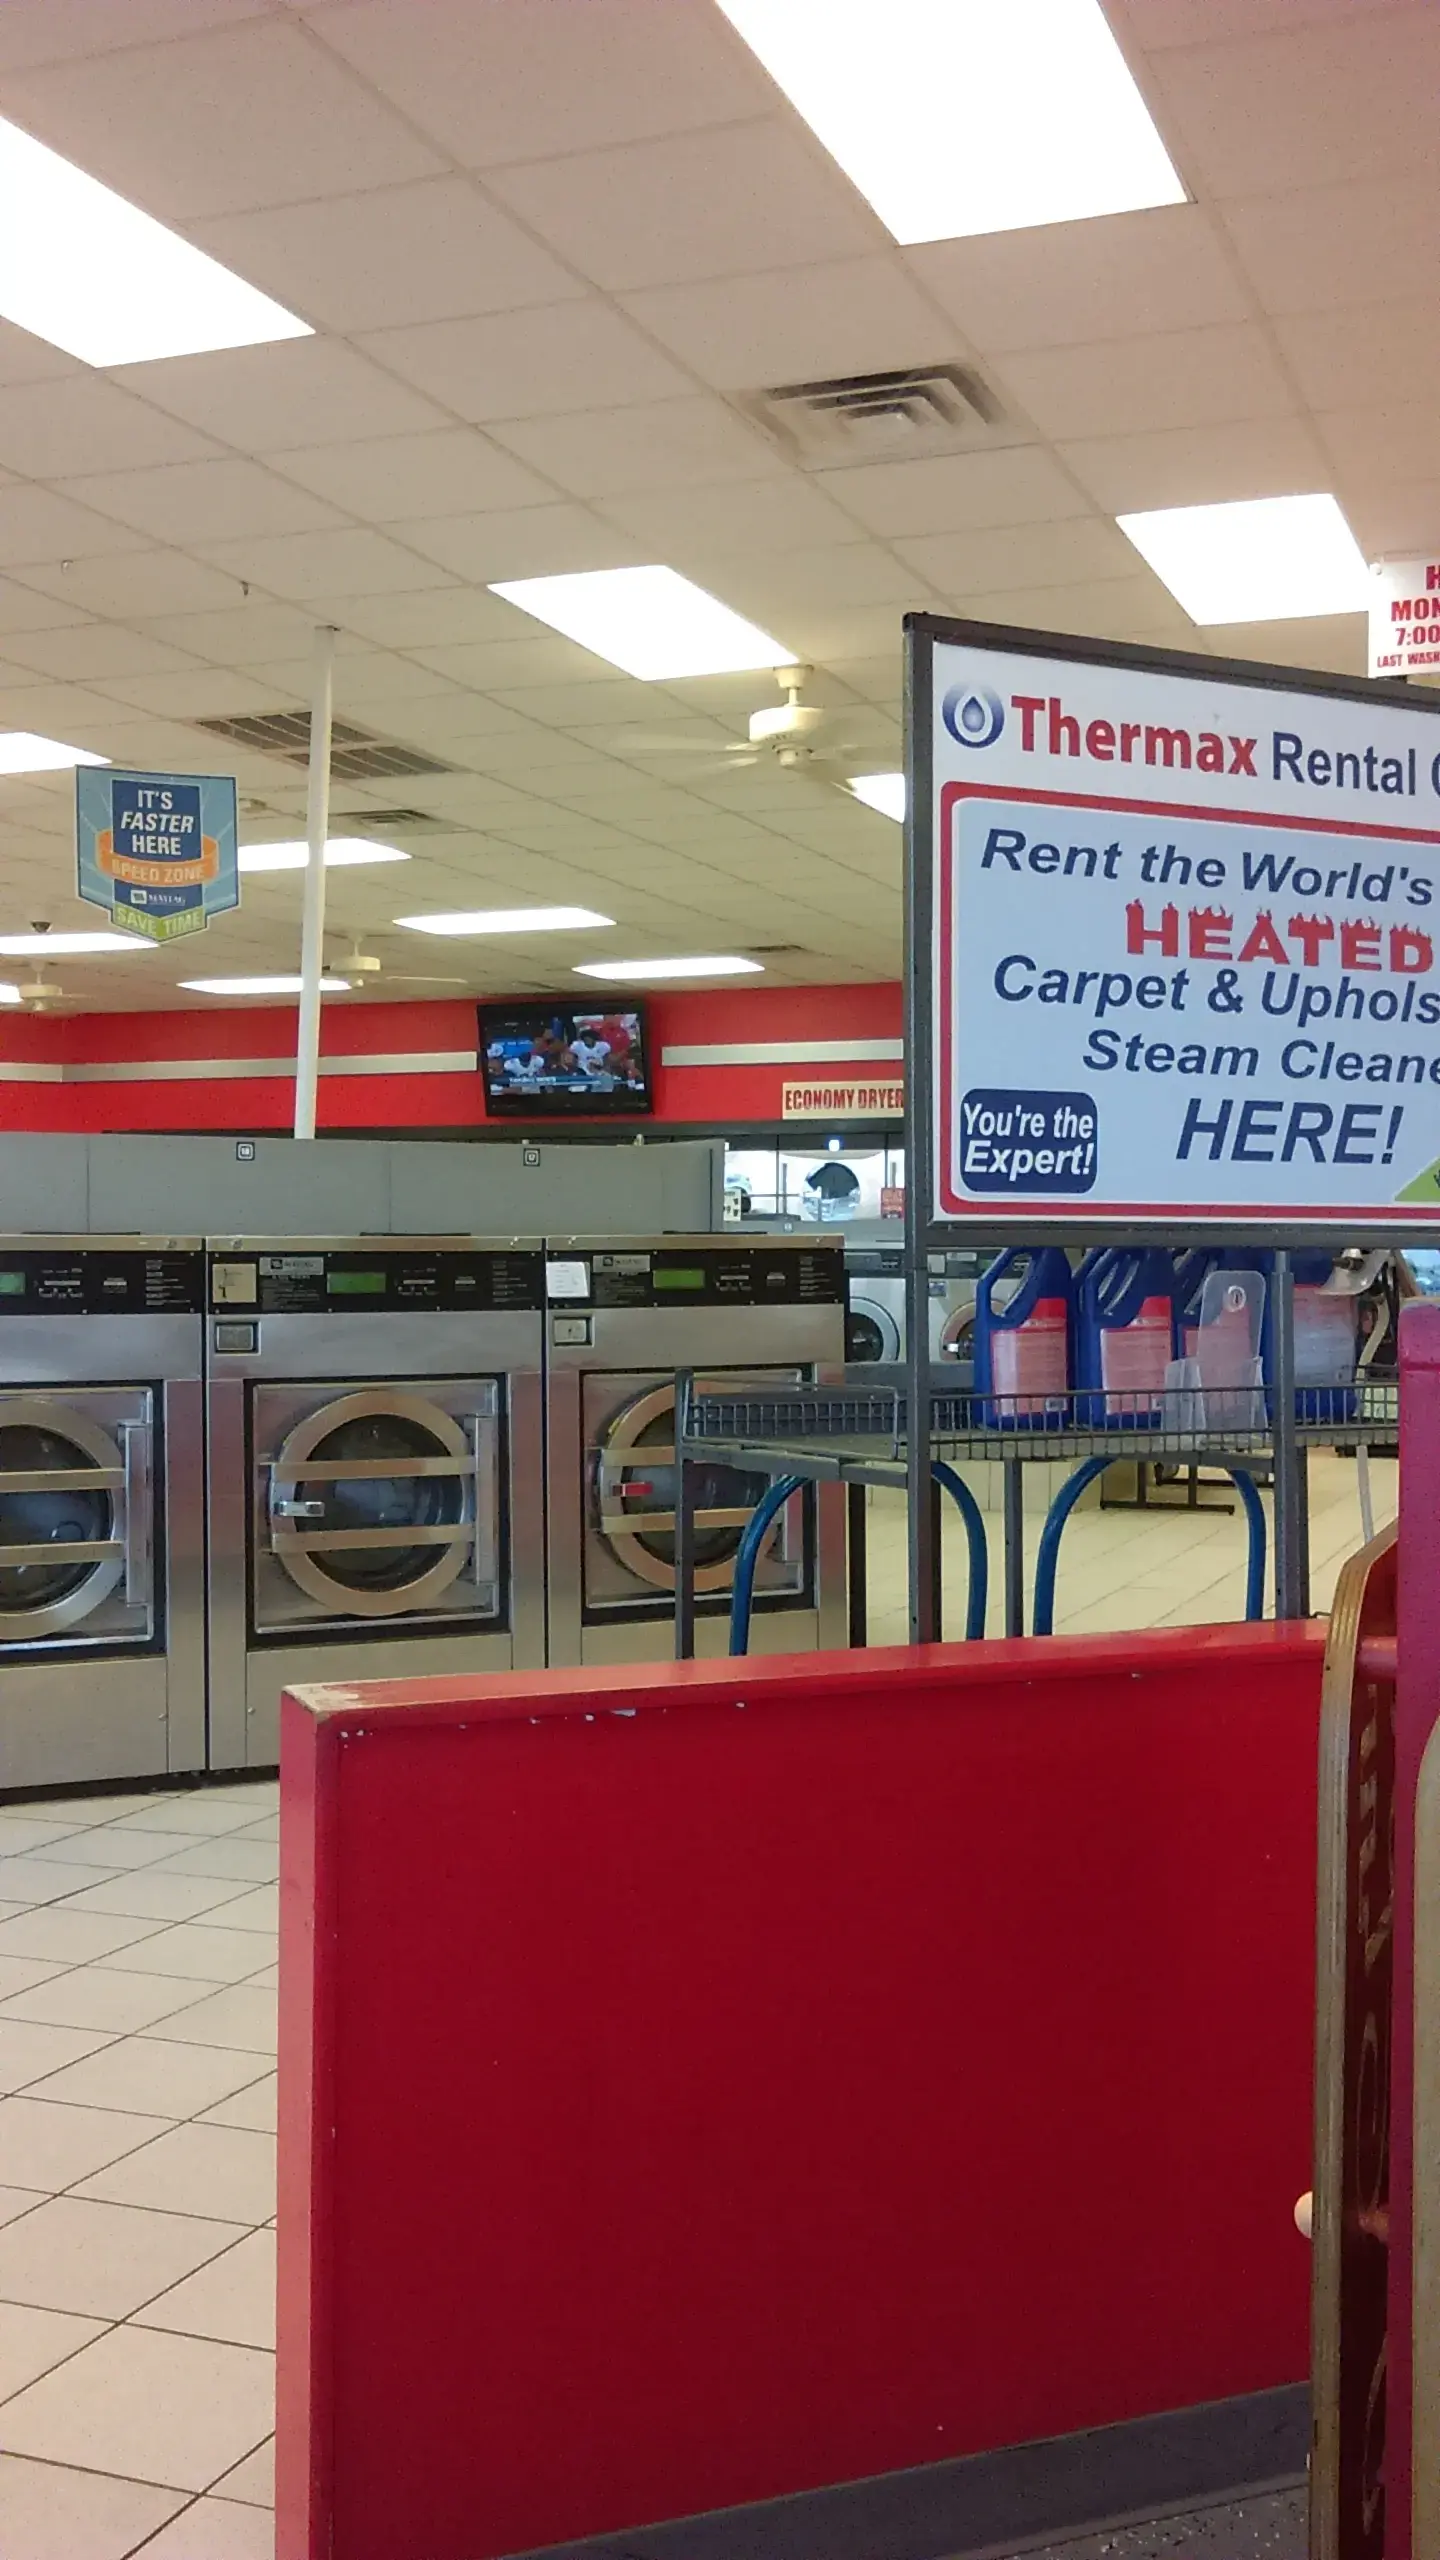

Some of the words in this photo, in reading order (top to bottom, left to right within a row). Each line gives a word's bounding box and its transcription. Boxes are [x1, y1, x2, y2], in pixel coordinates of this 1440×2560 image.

[1377, 654, 1402, 668] LAST
[1011, 696, 1258, 777] Thermax
[1272, 732, 1416, 796] Rental
[137, 789, 173, 810] IT'S
[120, 811, 194, 834] FASTER
[132, 834, 181, 855] HERE
[111, 859, 160, 881] SPEED
[164, 863, 204, 883] ZONE
[981, 828, 1122, 880] Rent
[1141, 845, 1226, 888] the
[1242, 852, 1433, 906] World's
[117, 907, 157, 935] SAVE
[163, 910, 200, 936] TIME
[1125, 898, 1433, 973] HEATED
[994, 955, 1189, 1017] Carpet
[1208, 968, 1244, 1014] &
[1083, 1029, 1259, 1077] Steam
[785, 1088, 854, 1110] ECONOMY
[858, 1087, 904, 1109] DRYER
[963, 1102, 1045, 1139] You're
[1054, 1106, 1094, 1139] the
[1176, 1097, 1404, 1166] HERE!
[964, 1140, 1094, 1181] Expert!
